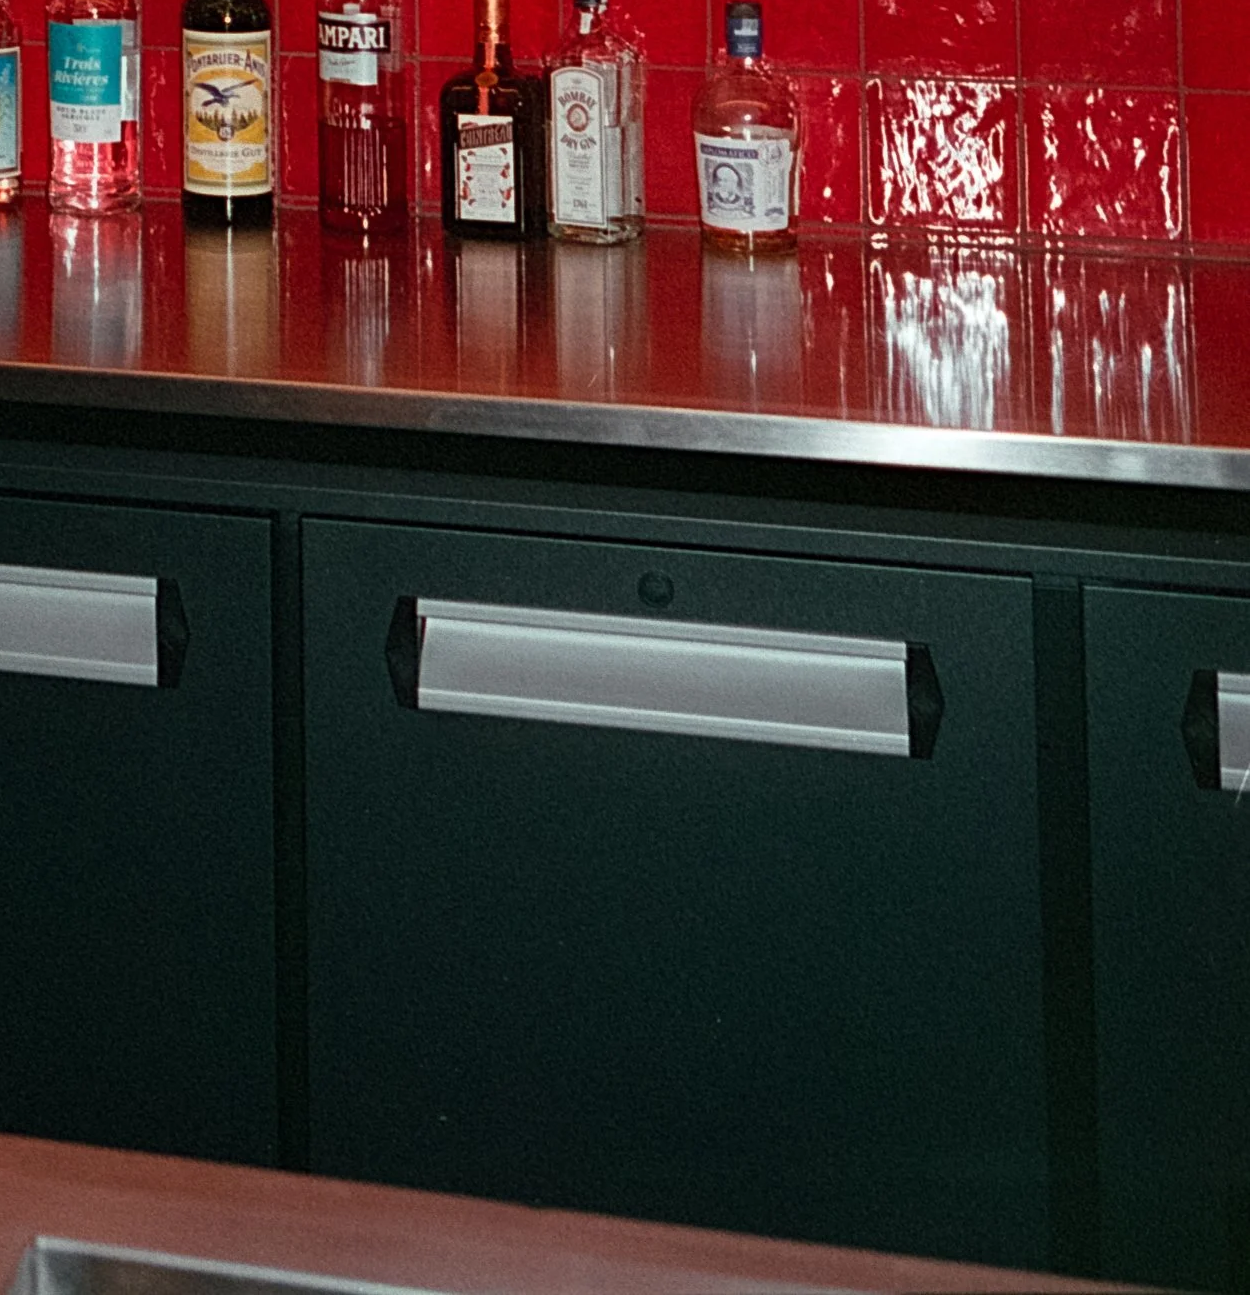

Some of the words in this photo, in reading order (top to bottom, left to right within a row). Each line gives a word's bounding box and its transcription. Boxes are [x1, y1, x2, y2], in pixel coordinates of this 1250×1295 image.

[557, 91, 597, 110] BOMBAY
[560, 133, 579, 151] DRY
[579, 136, 597, 151] GIN
